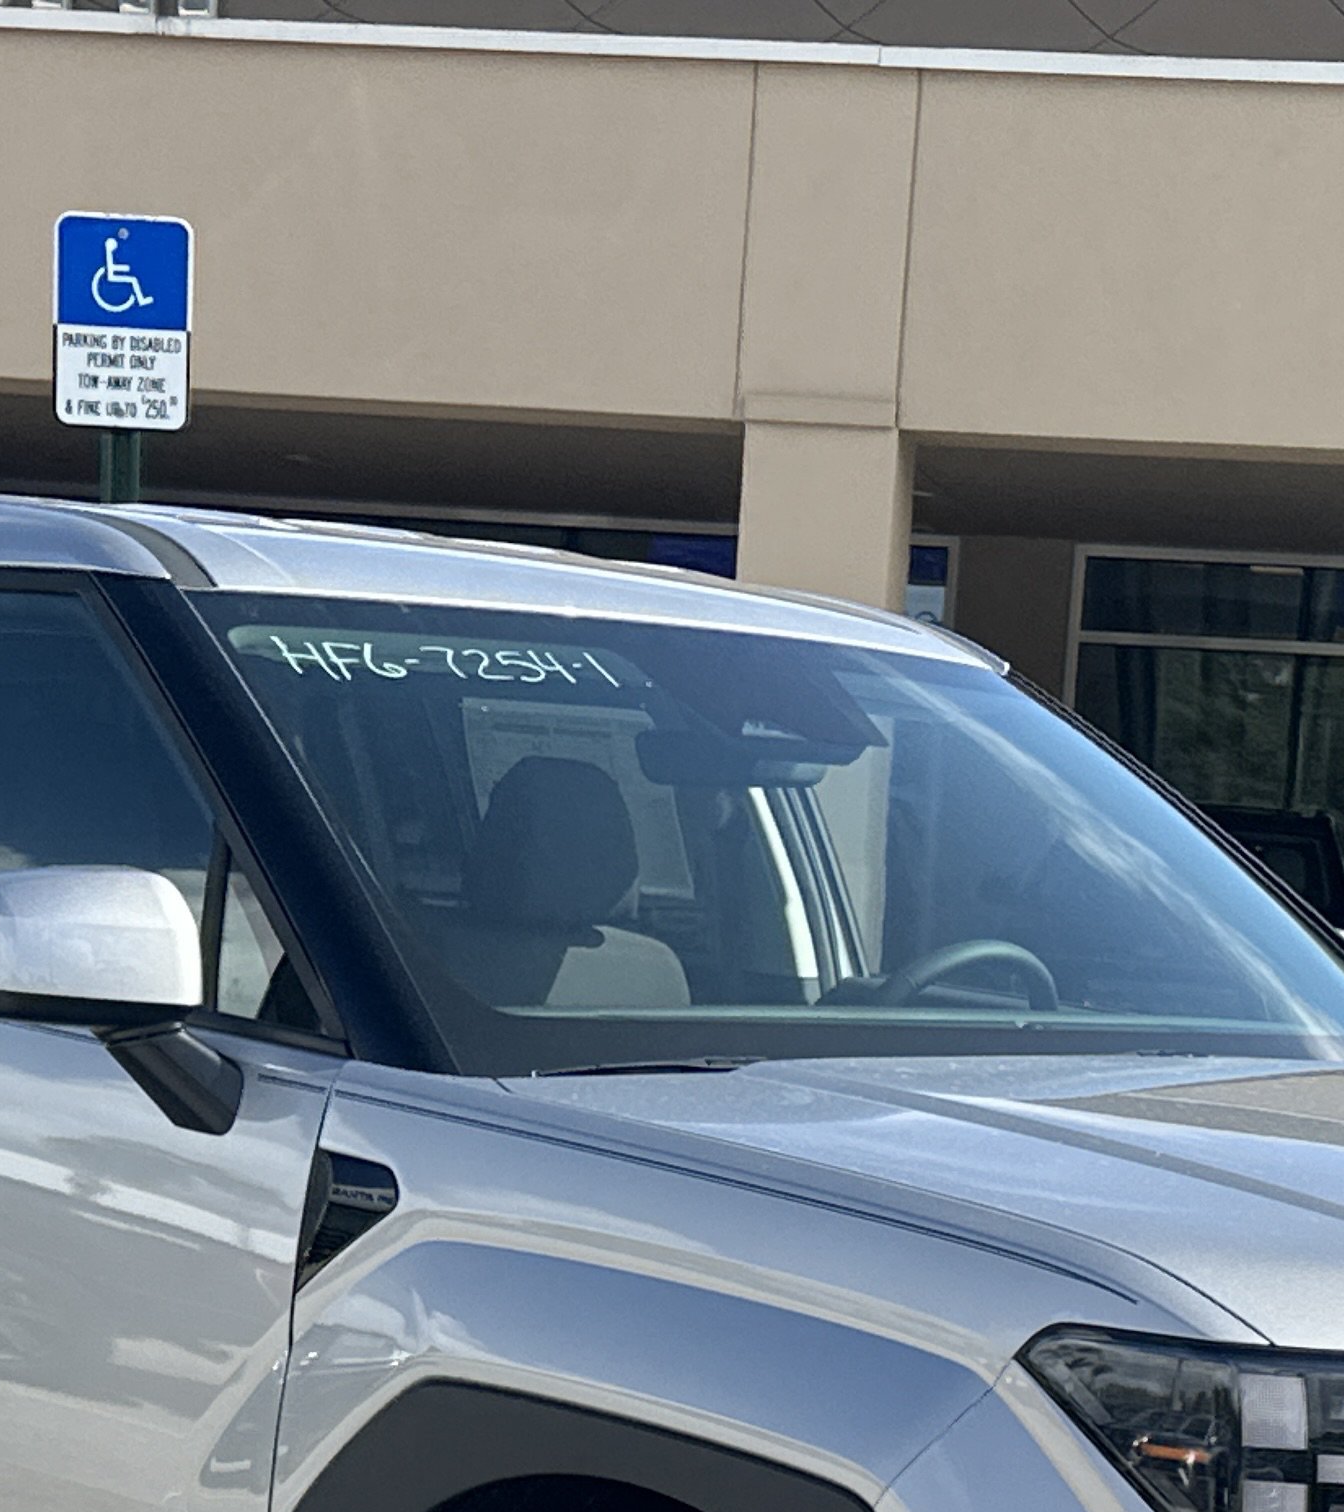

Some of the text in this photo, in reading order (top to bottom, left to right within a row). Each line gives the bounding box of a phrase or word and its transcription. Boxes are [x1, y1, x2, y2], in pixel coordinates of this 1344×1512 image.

[62, 332, 182, 353] PARKING BY DISABLED
[87, 354, 156, 371] PERMIT ONLY
[78, 373, 166, 393] TOW-AWAY ZONE
[65, 399, 73, 415] &
[77, 400, 101, 416] FINE
[269, 634, 621, 688] HF6-7254-1
